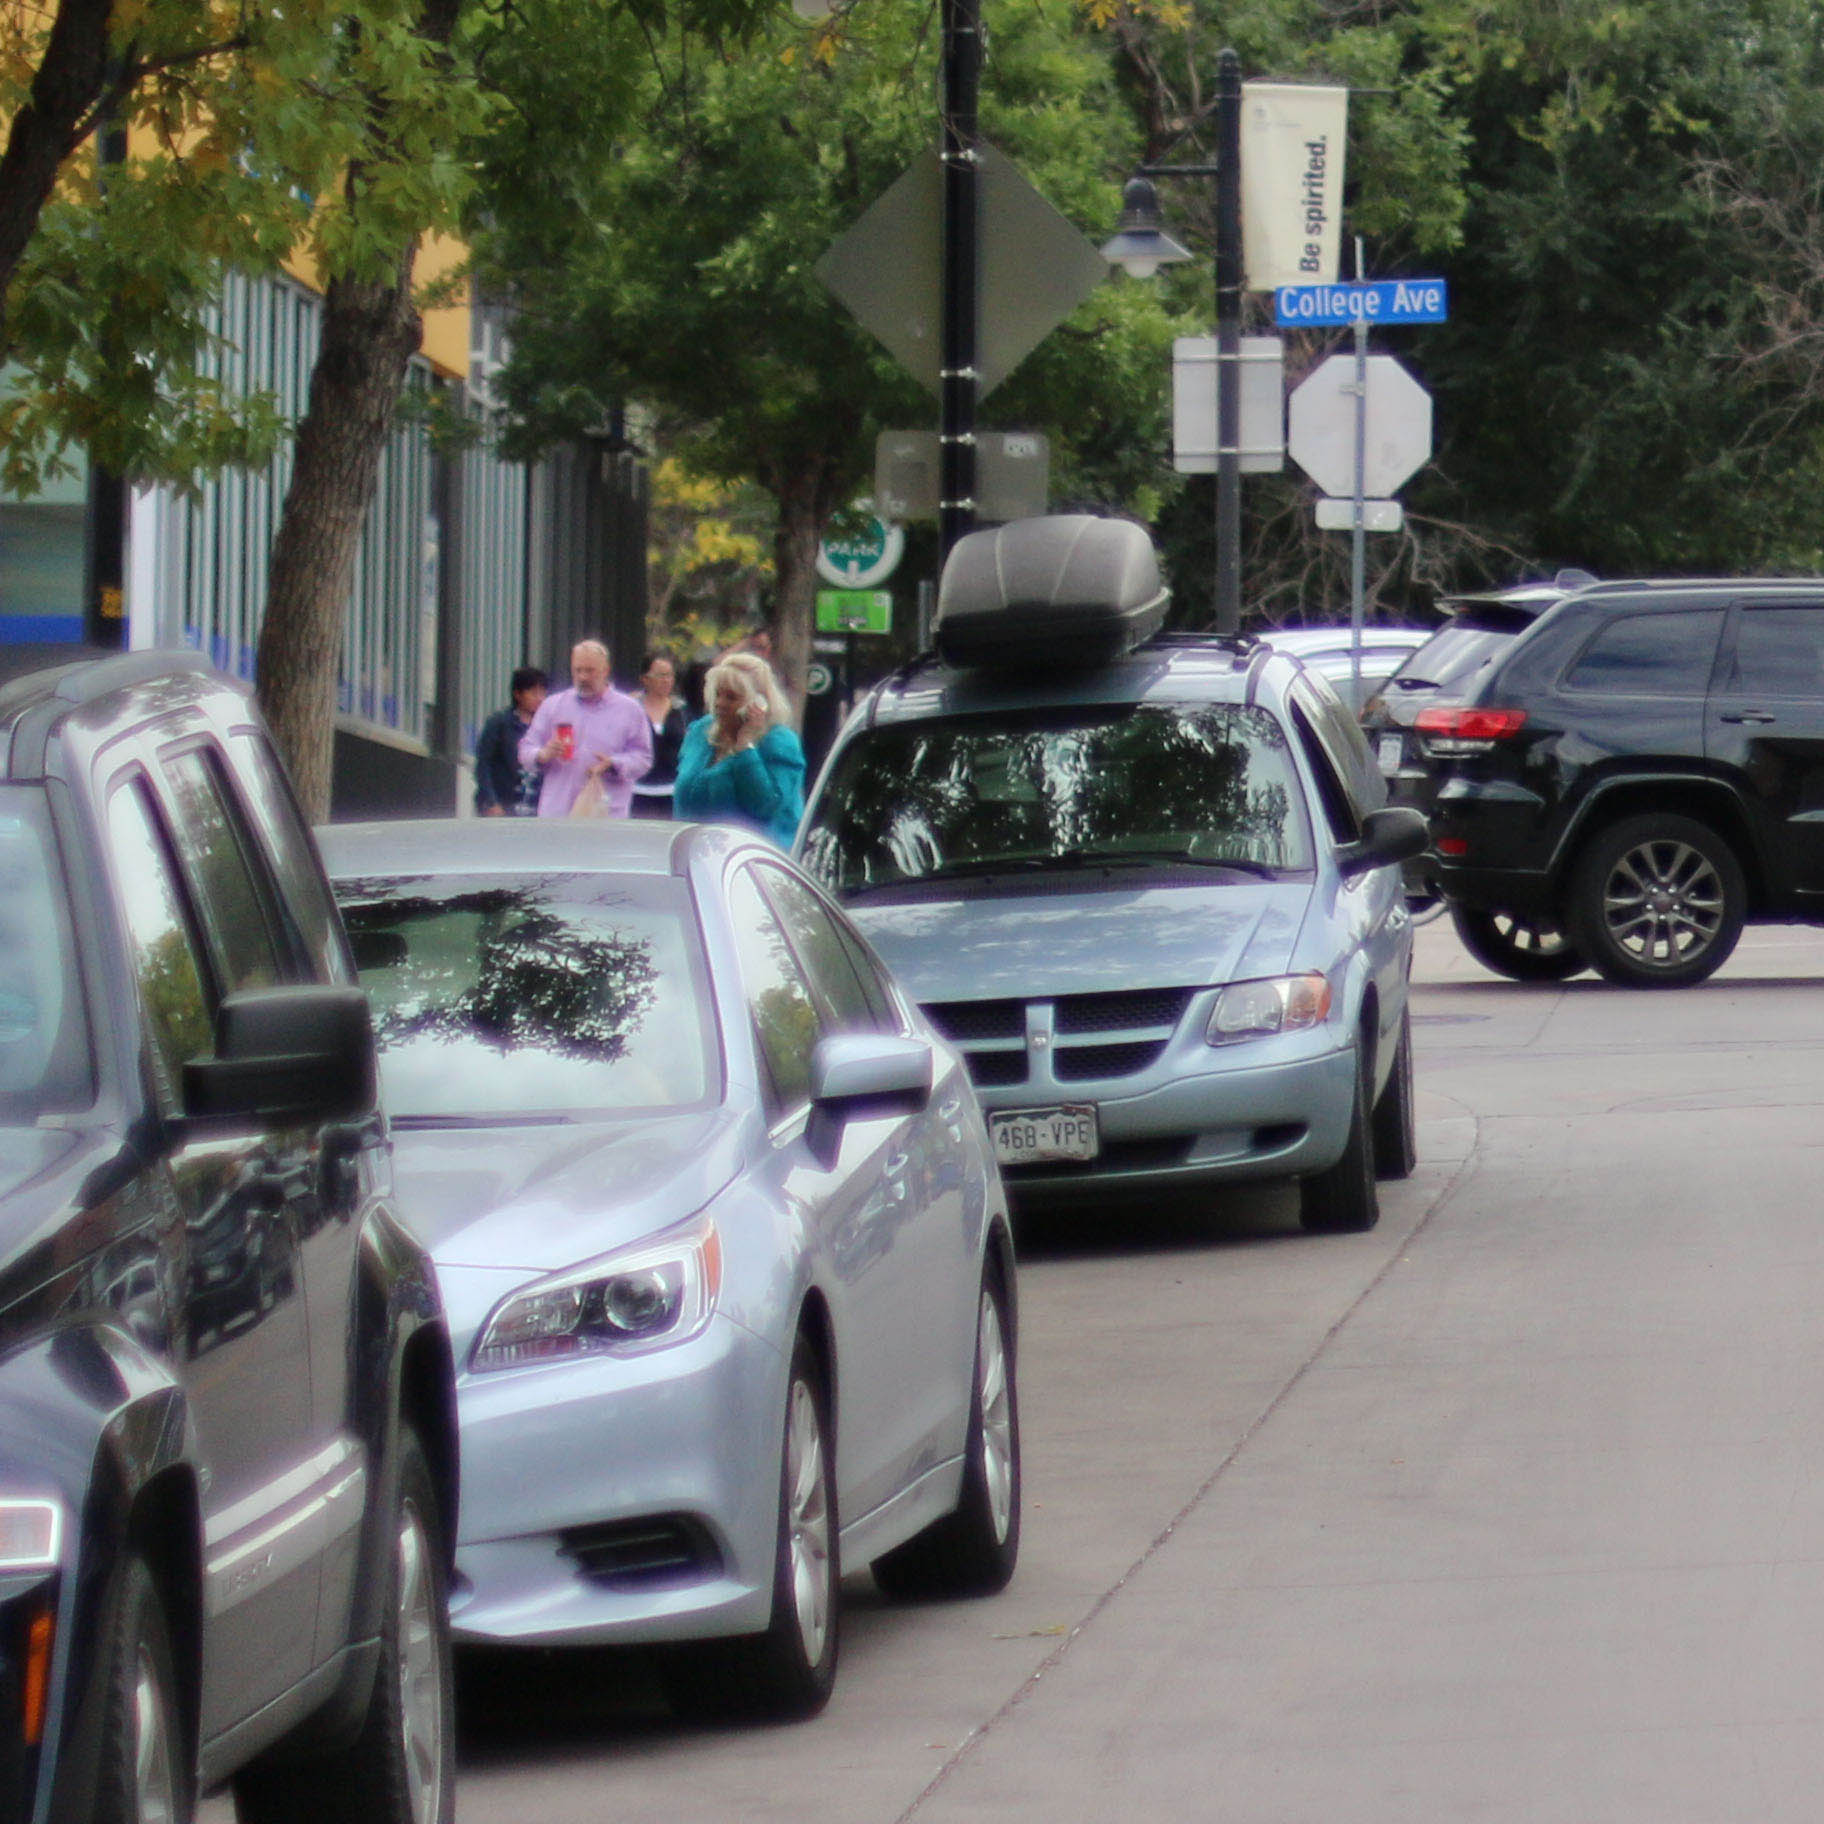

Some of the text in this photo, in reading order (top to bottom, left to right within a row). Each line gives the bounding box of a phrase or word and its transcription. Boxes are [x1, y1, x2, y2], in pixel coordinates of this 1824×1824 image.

[1299, 134, 1328, 273] Be spirited.
[1279, 282, 1440, 320] College Ave
